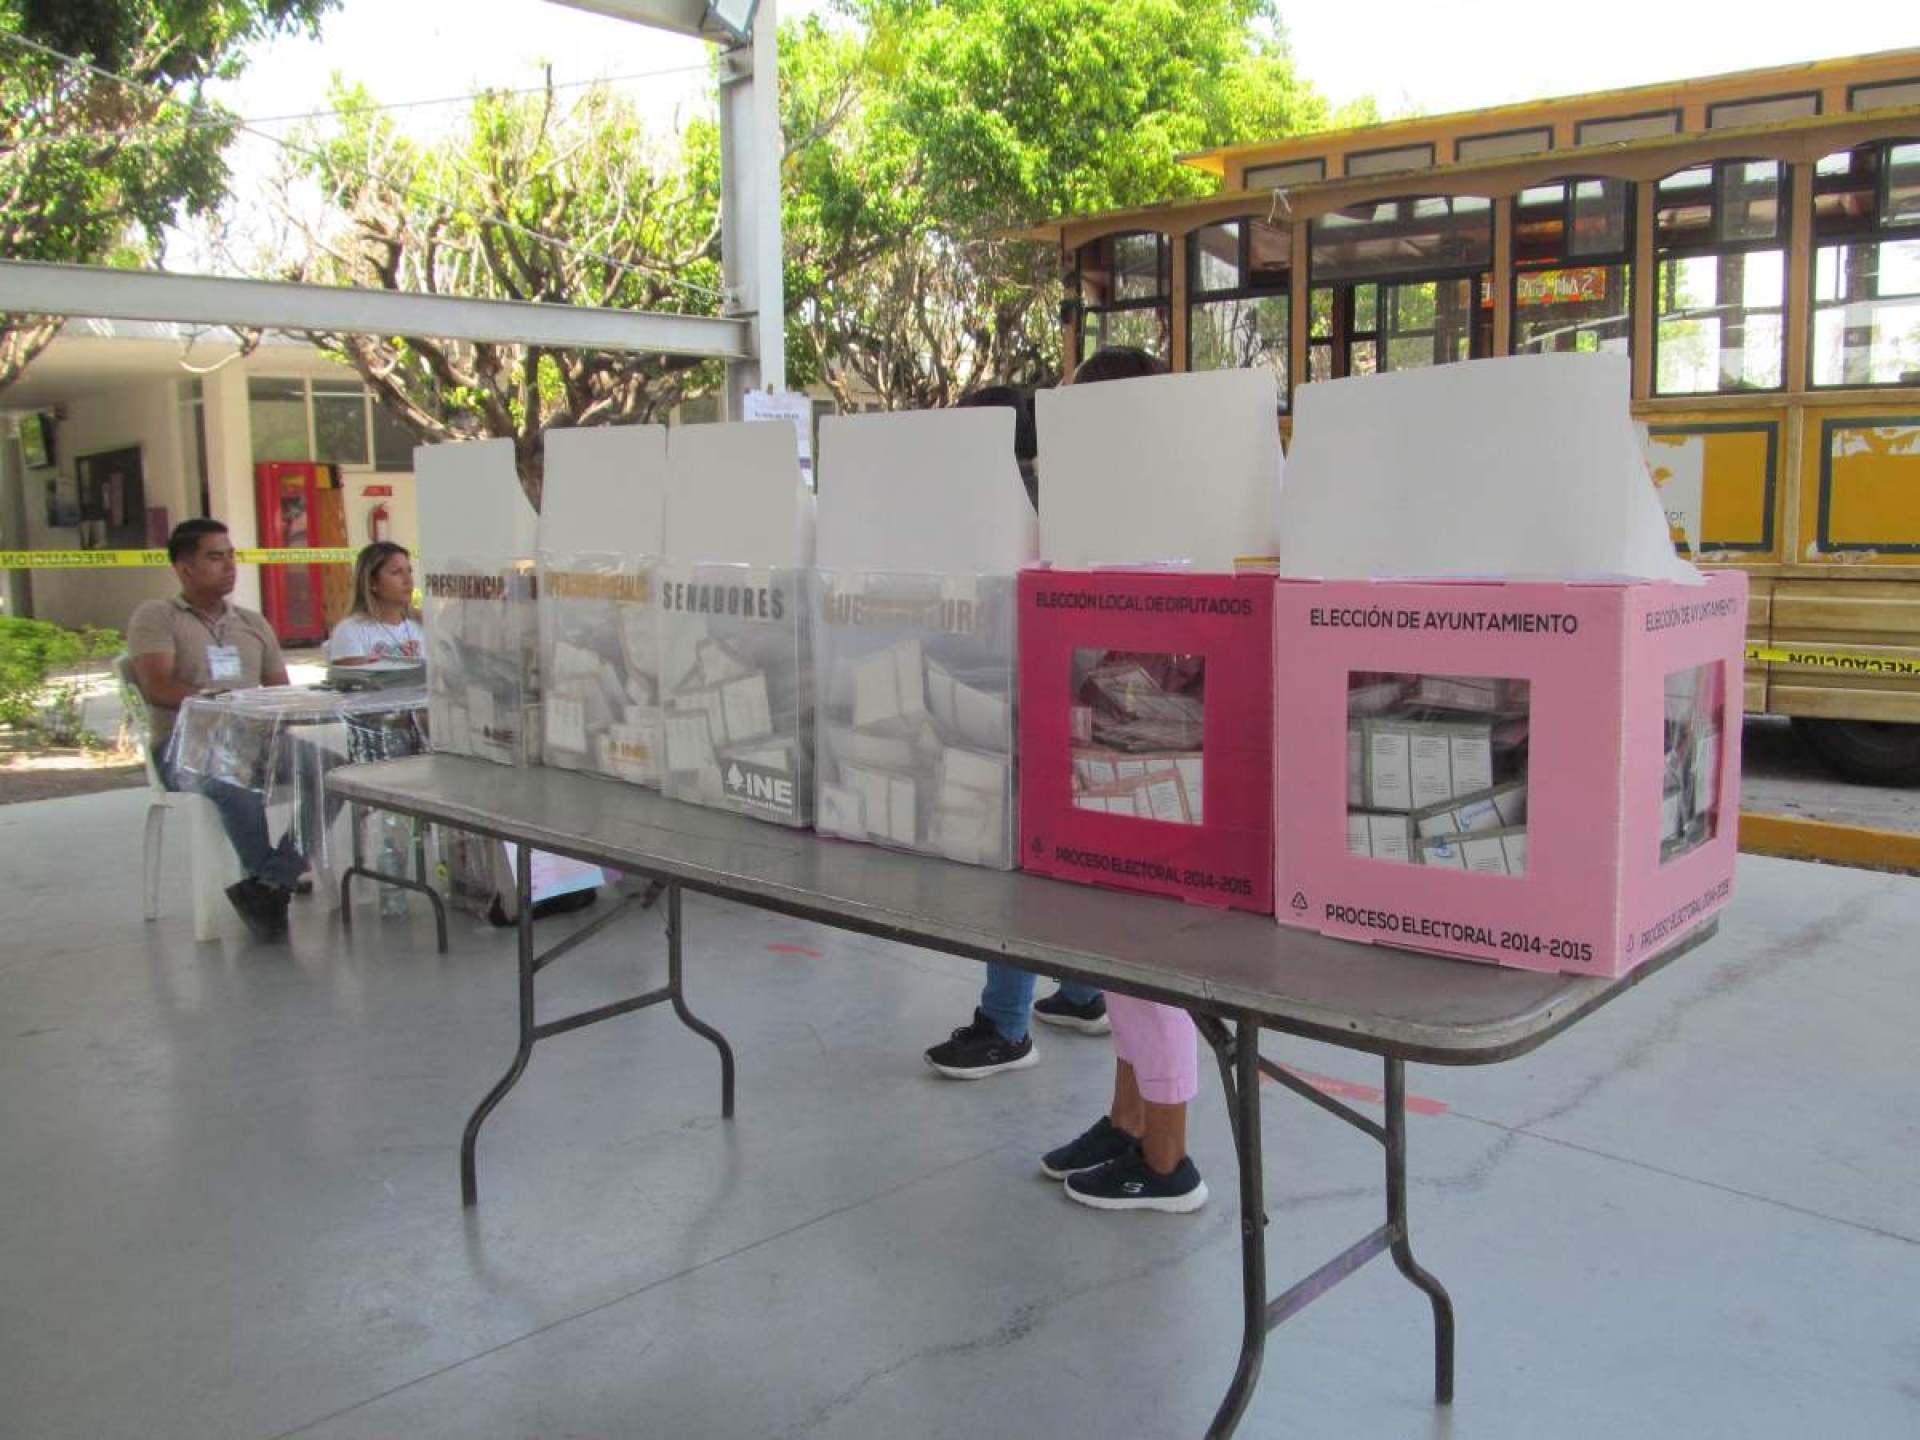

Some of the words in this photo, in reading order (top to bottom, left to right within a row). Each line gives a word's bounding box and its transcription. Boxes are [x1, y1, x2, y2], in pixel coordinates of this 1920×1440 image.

[663, 582, 784, 620] SENADORES
[1036, 588, 1097, 610] ELECCIÓN
[1100, 594, 1145, 612] LOCAL
[1148, 595, 1164, 612] DE
[1166, 596, 1252, 615] DIPUTADOS
[1310, 605, 1393, 628] ELECCIÓN
[1397, 610, 1420, 629] DE
[1423, 611, 1578, 634] AYUNTAMIENTO
[746, 772, 792, 805] INE
[1056, 846, 1110, 871] PROCESO
[1111, 856, 1181, 884] ELECTORAL
[1184, 869, 1252, 895] 2014-2015
[1326, 903, 1399, 931] PROCESO
[1402, 916, 1496, 947] ELECTORAL
[1500, 931, 1593, 961] 2014-2015
